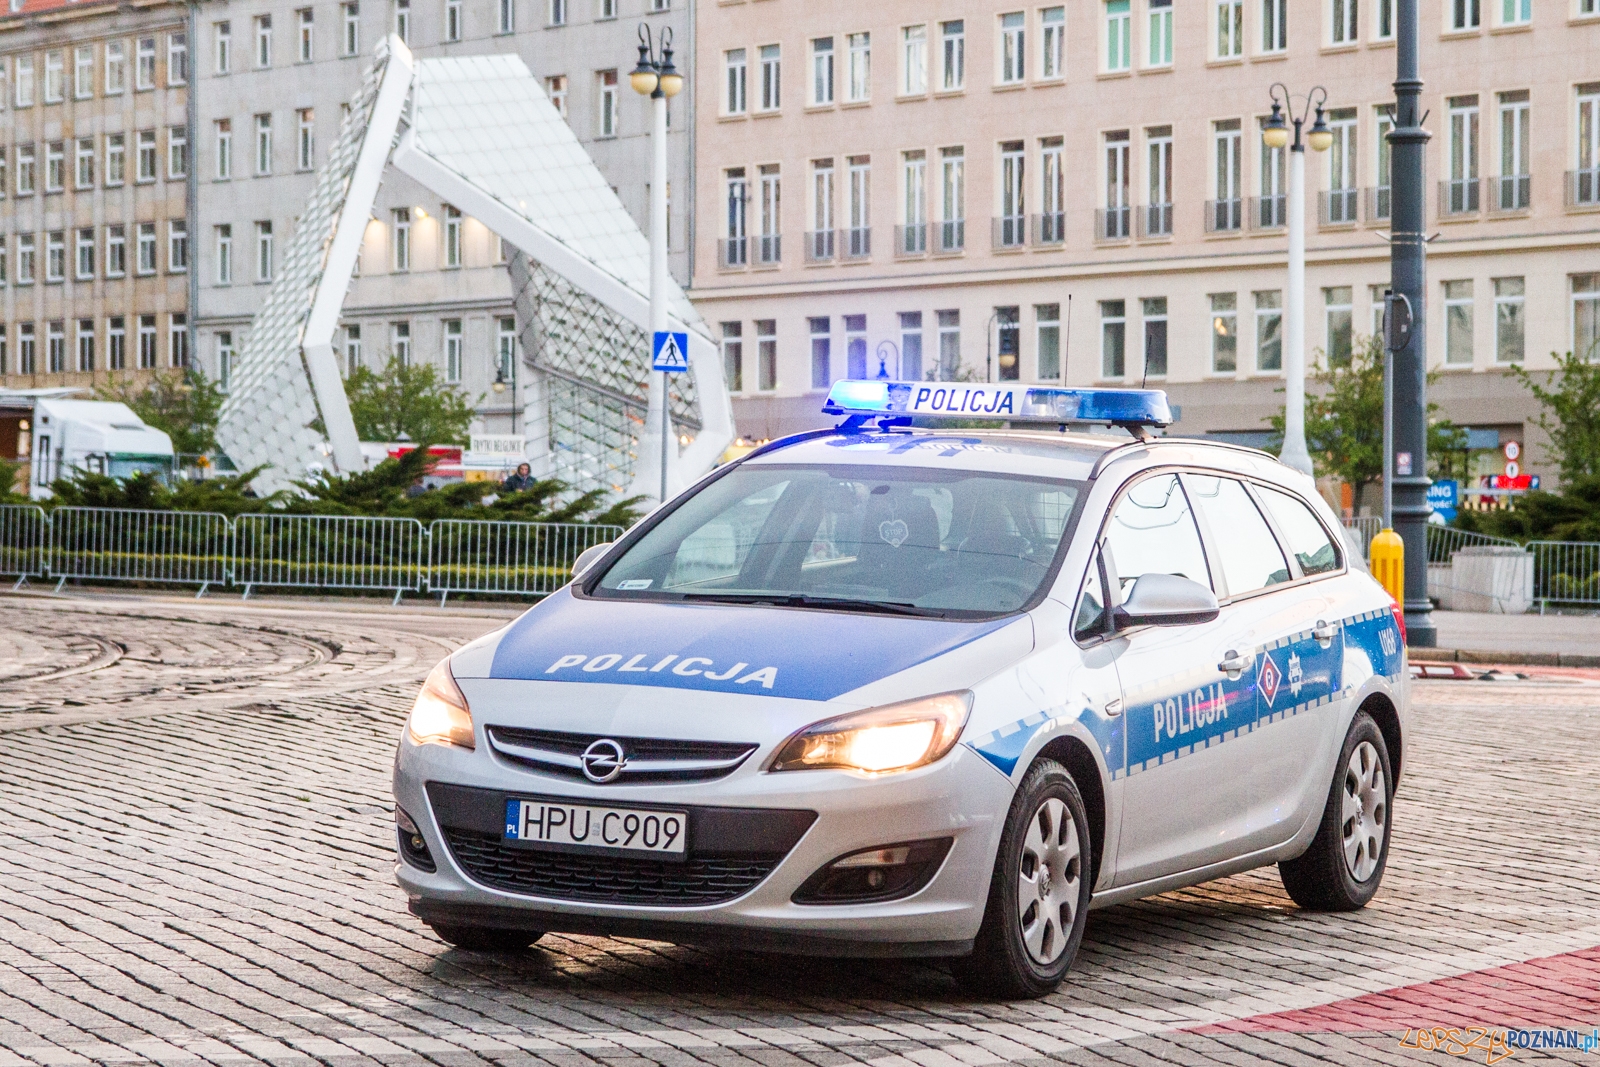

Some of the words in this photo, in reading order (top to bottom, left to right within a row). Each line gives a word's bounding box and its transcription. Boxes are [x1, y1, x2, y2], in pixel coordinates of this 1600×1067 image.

[913, 387, 1014, 414] POLICJA
[544, 653, 778, 689] POLICJA
[1154, 682, 1228, 743] POLICJA
[506, 824, 517, 834] PL
[524, 805, 591, 842] HPU
[602, 812, 680, 850] C909
